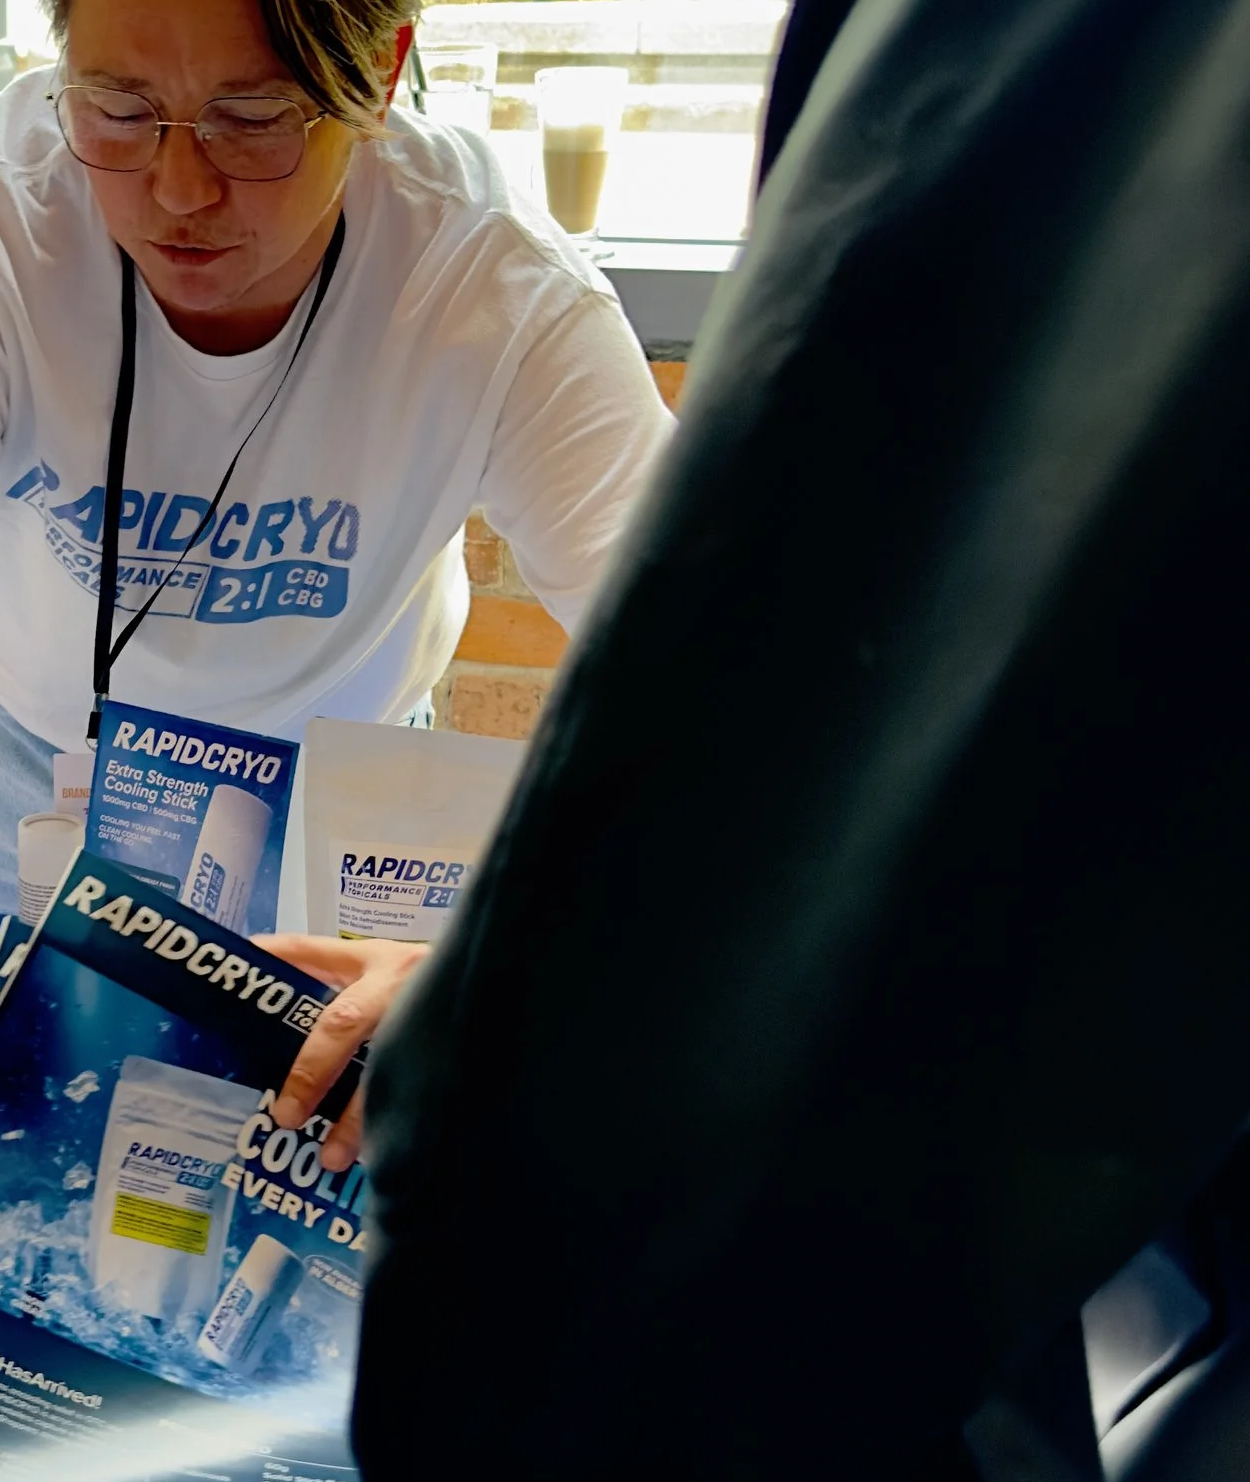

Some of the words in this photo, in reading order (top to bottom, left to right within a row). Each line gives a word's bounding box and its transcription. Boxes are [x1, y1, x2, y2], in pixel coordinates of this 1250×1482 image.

[209, 571, 273, 614] 2:1
[287, 568, 330, 588] CBD
[278, 588, 324, 608] CBG
[112, 721, 282, 785] RAPIDCRYO
[104, 775, 159, 804] Cooling
[161, 789, 199, 811] Stick
[106, 759, 144, 781] Extra
[146, 769, 210, 798] Strength
[102, 794, 131, 809] 1000mg
[132, 802, 148, 812] CBD
[341, 853, 466, 886] RAPIDCR
[348, 881, 423, 896] PERFORMANCE
[348, 888, 391, 901] TOPICALS
[63, 875, 295, 1015] RAPIDCRYO
[128, 1142, 226, 1180] RAPIDCRYO
[220, 1161, 326, 1228] EVERY
